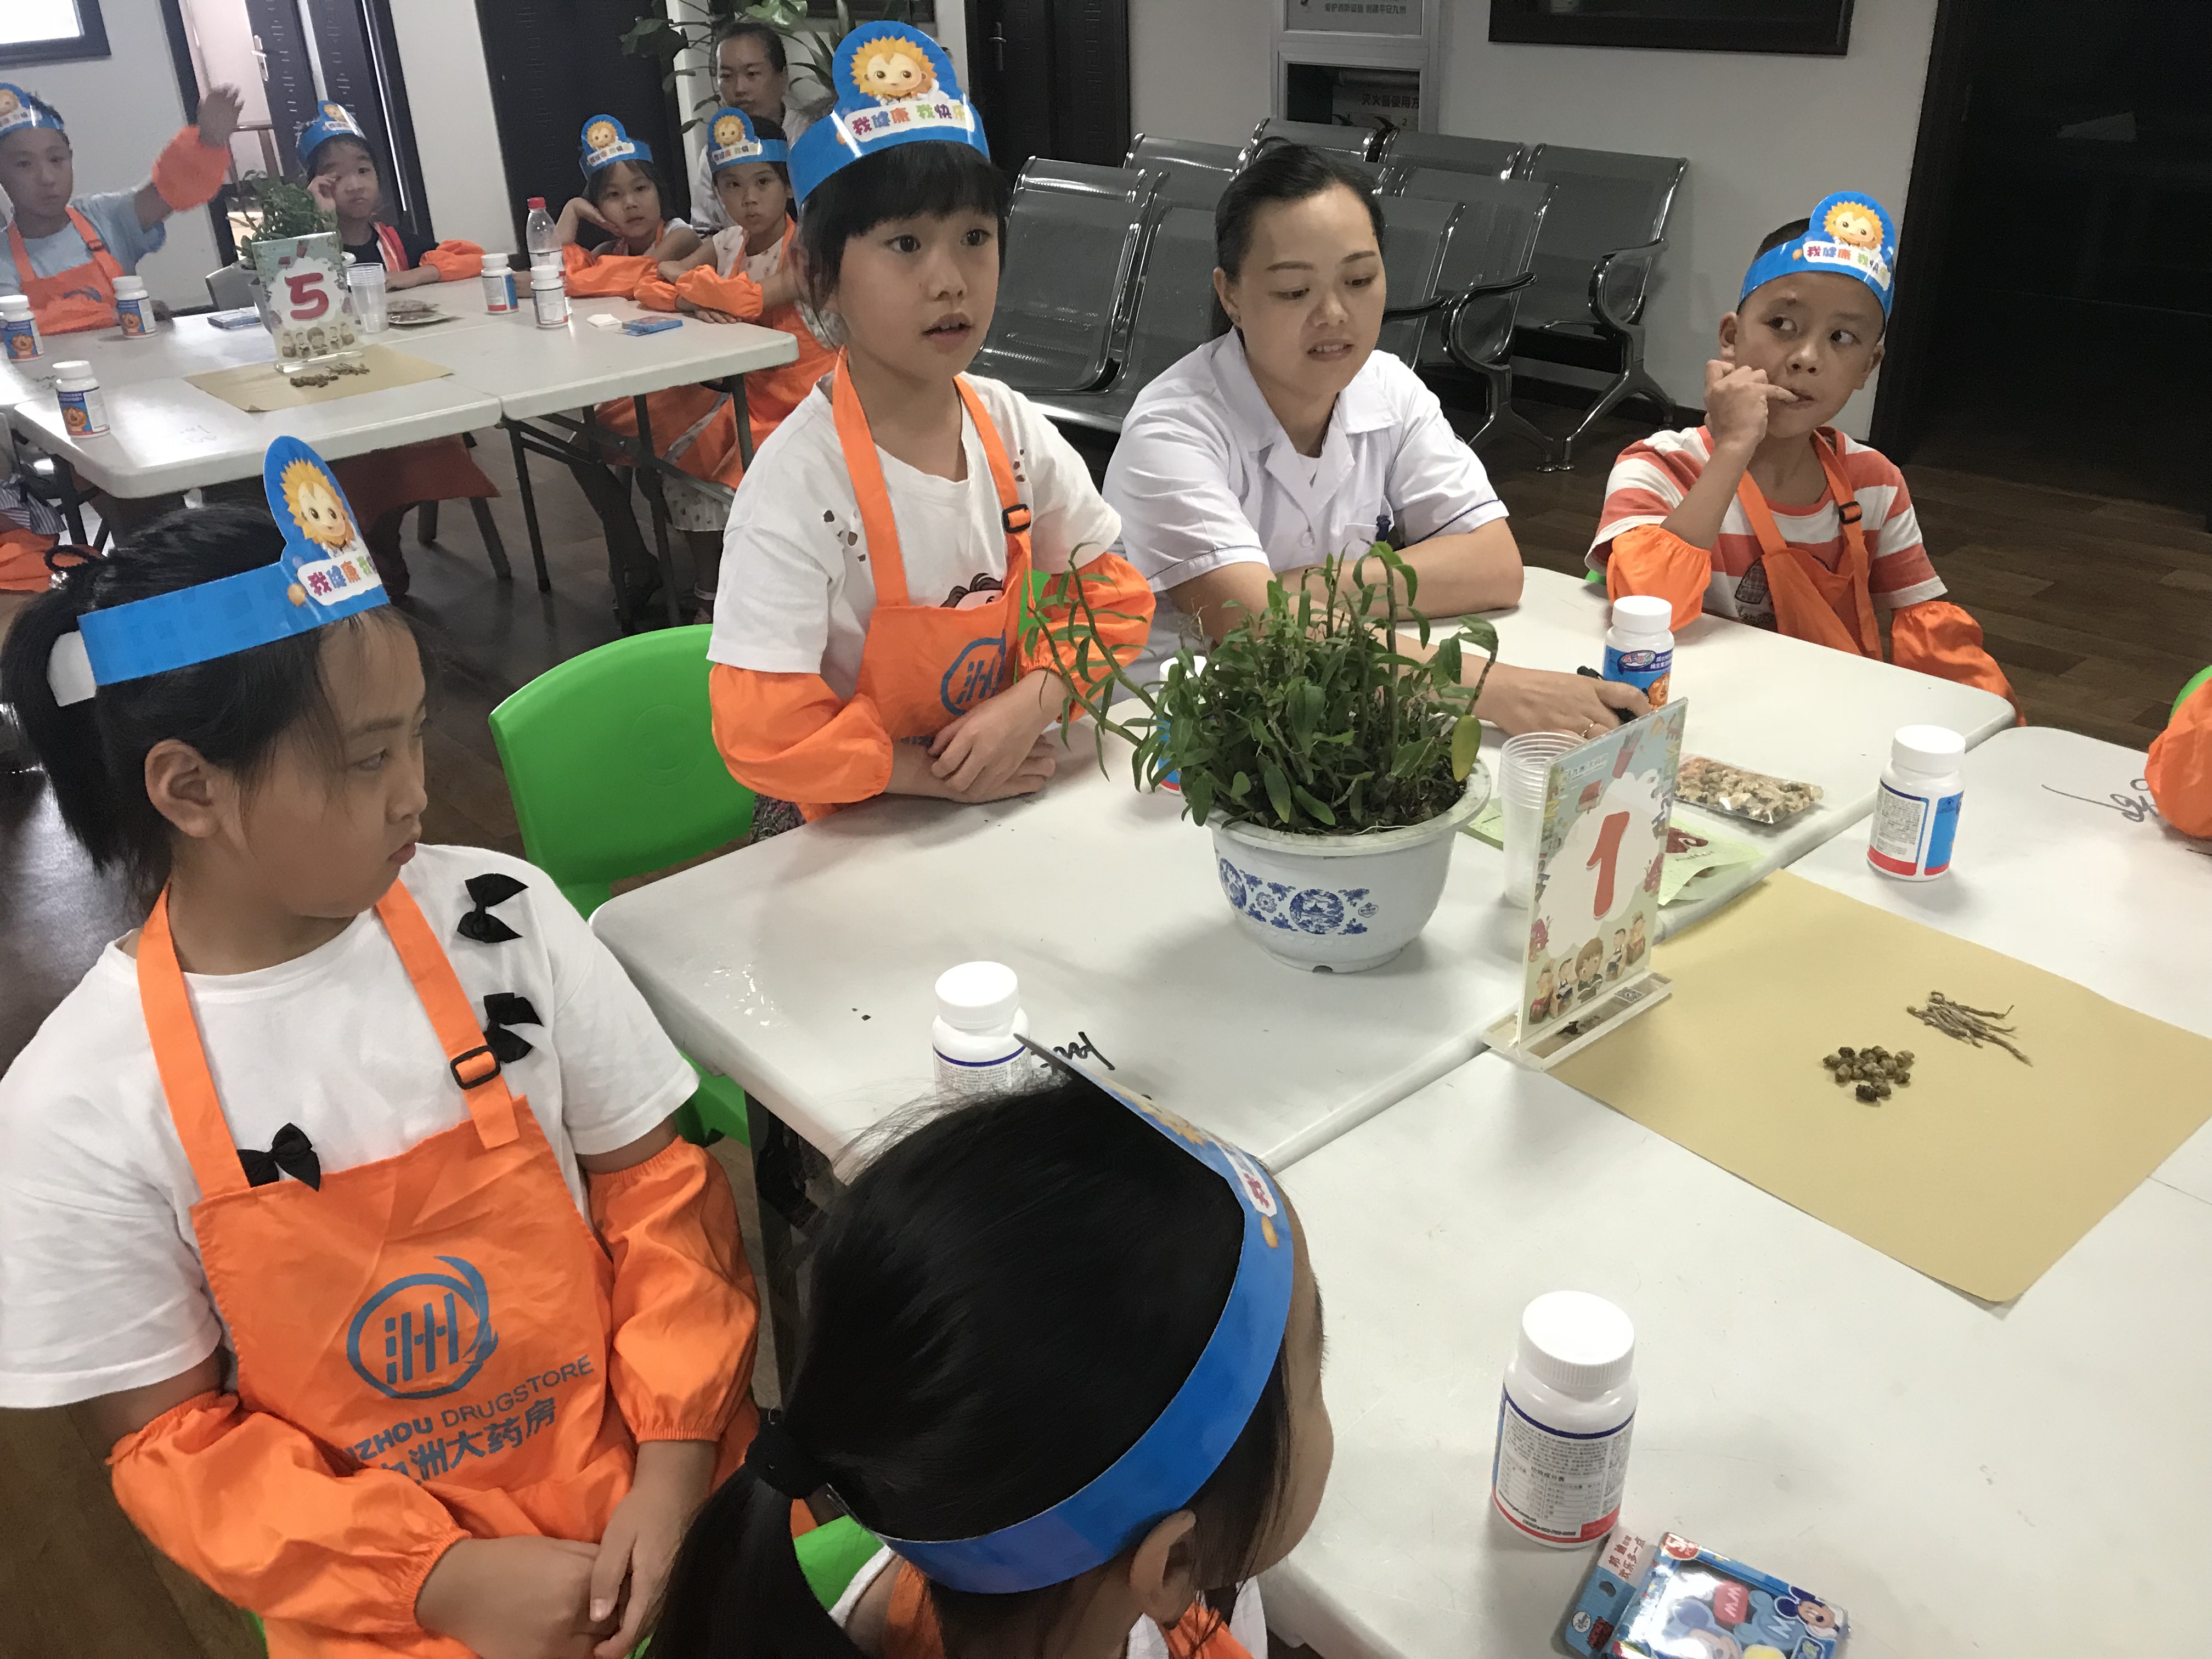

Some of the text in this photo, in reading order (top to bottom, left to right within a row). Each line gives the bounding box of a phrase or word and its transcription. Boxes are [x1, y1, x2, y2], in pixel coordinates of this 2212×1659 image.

[852, 108, 911, 136] 我健康
[1402, 118, 1407, 126] 2
[1807, 246, 1891, 284] 我健康 我快
[285, 273, 329, 320] 5
[307, 561, 361, 596] 我健康
[1586, 811, 1630, 918] 1
[442, 1354, 594, 1428] DRUGSTORE
[1618, 1536, 1646, 1581] 欢乐多一点
